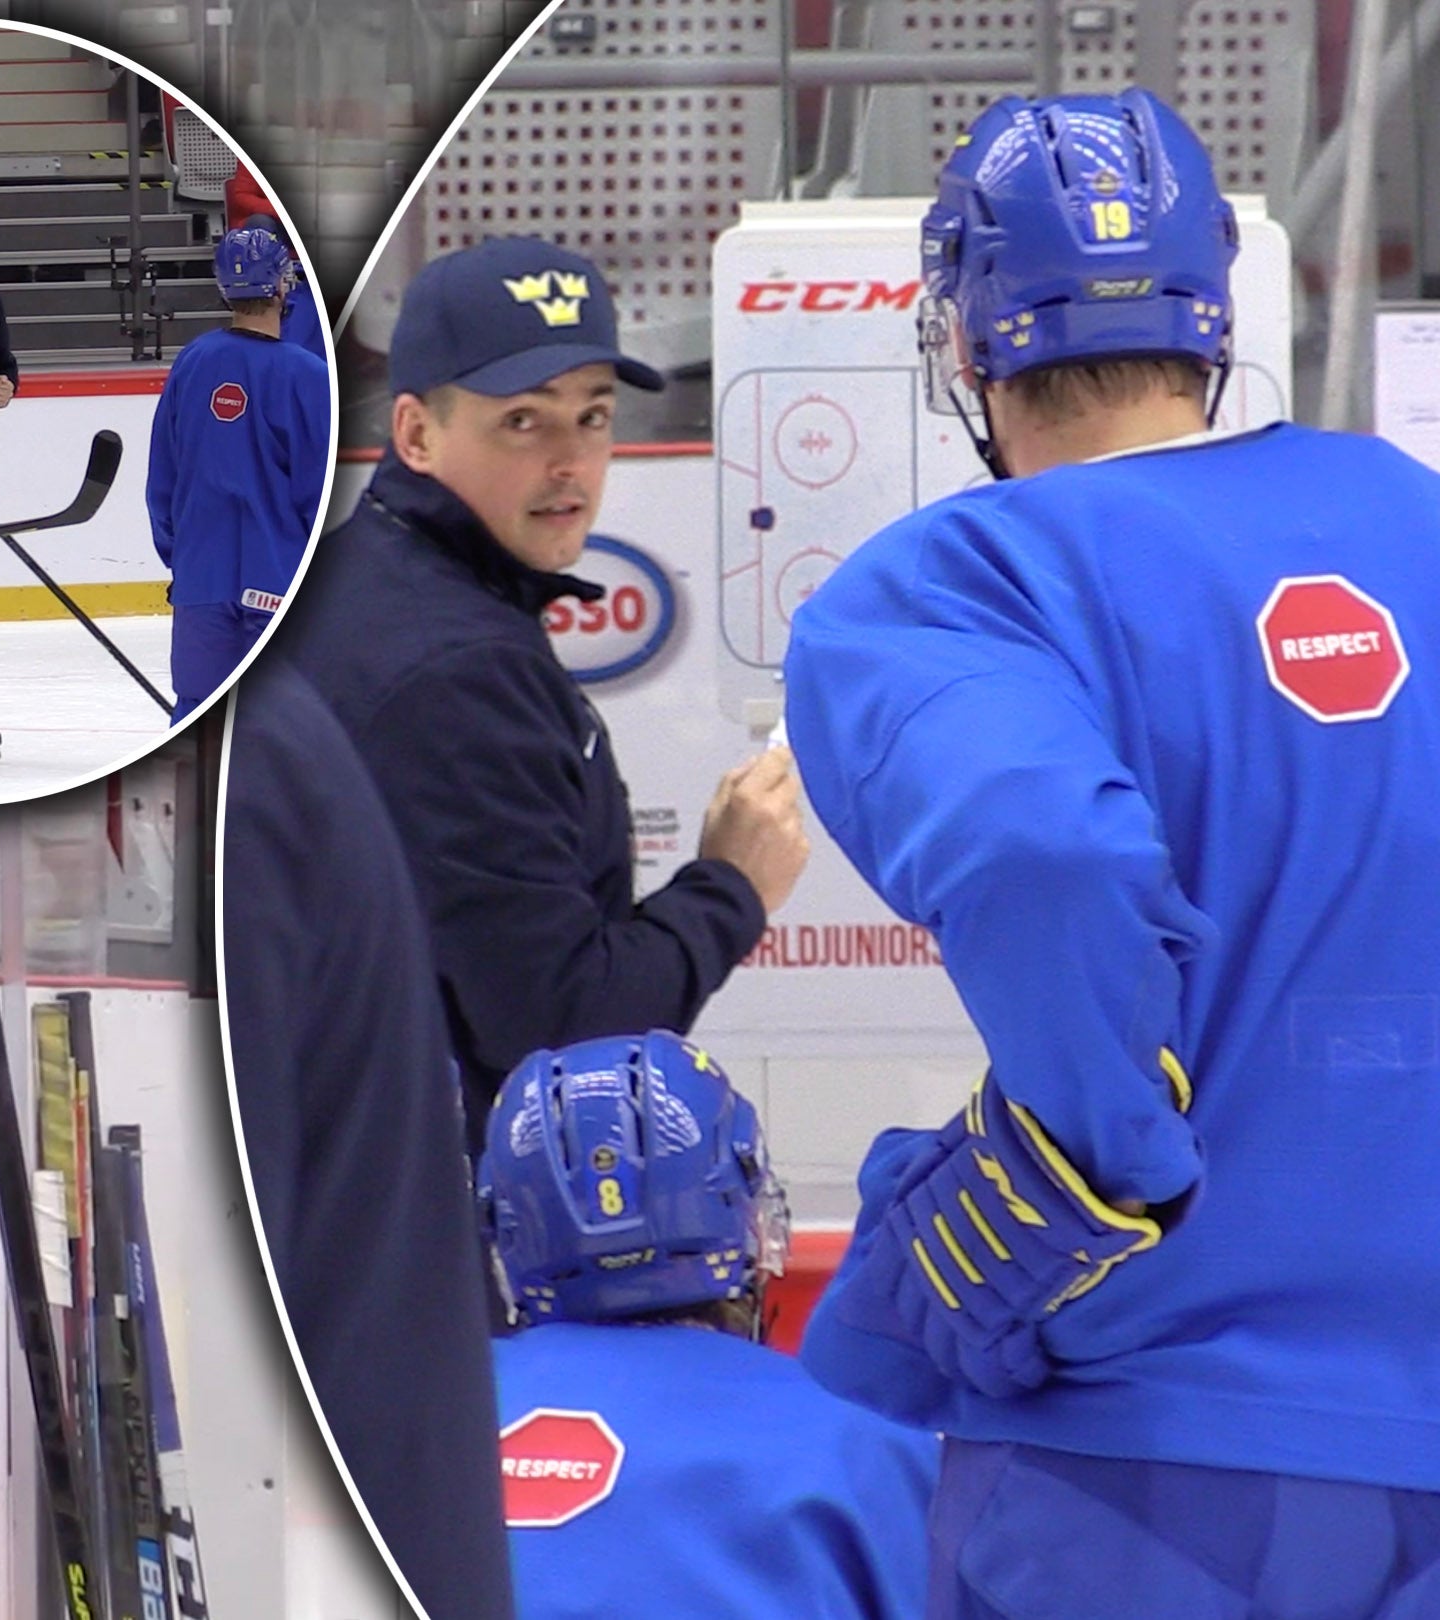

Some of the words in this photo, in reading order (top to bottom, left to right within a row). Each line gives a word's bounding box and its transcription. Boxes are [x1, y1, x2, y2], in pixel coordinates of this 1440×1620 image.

[1090, 201, 1131, 240] 19
[738, 279, 922, 313] CCM
[1280, 631, 1382, 662] RESPECT
[740, 923, 943, 968] RLDJUNIOR
[599, 1178, 623, 1216] 8
[502, 1457, 602, 1481] RESPECT
